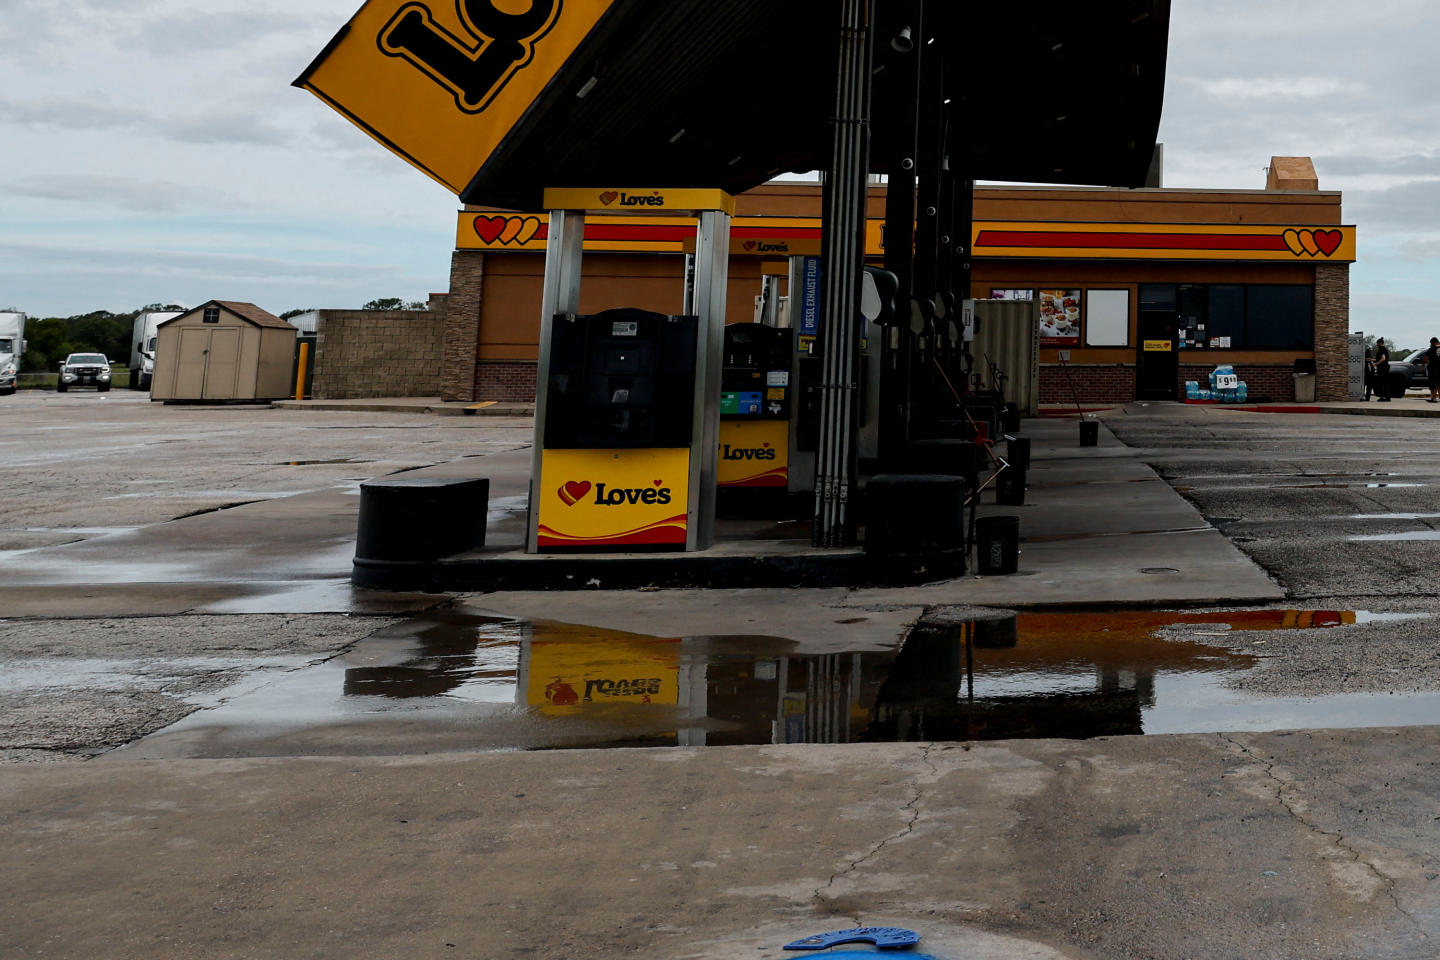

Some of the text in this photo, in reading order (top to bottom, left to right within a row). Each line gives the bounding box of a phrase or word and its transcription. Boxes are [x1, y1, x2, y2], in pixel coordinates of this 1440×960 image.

[805, 259, 817, 328] DIESEL EXHAUST FLUID
